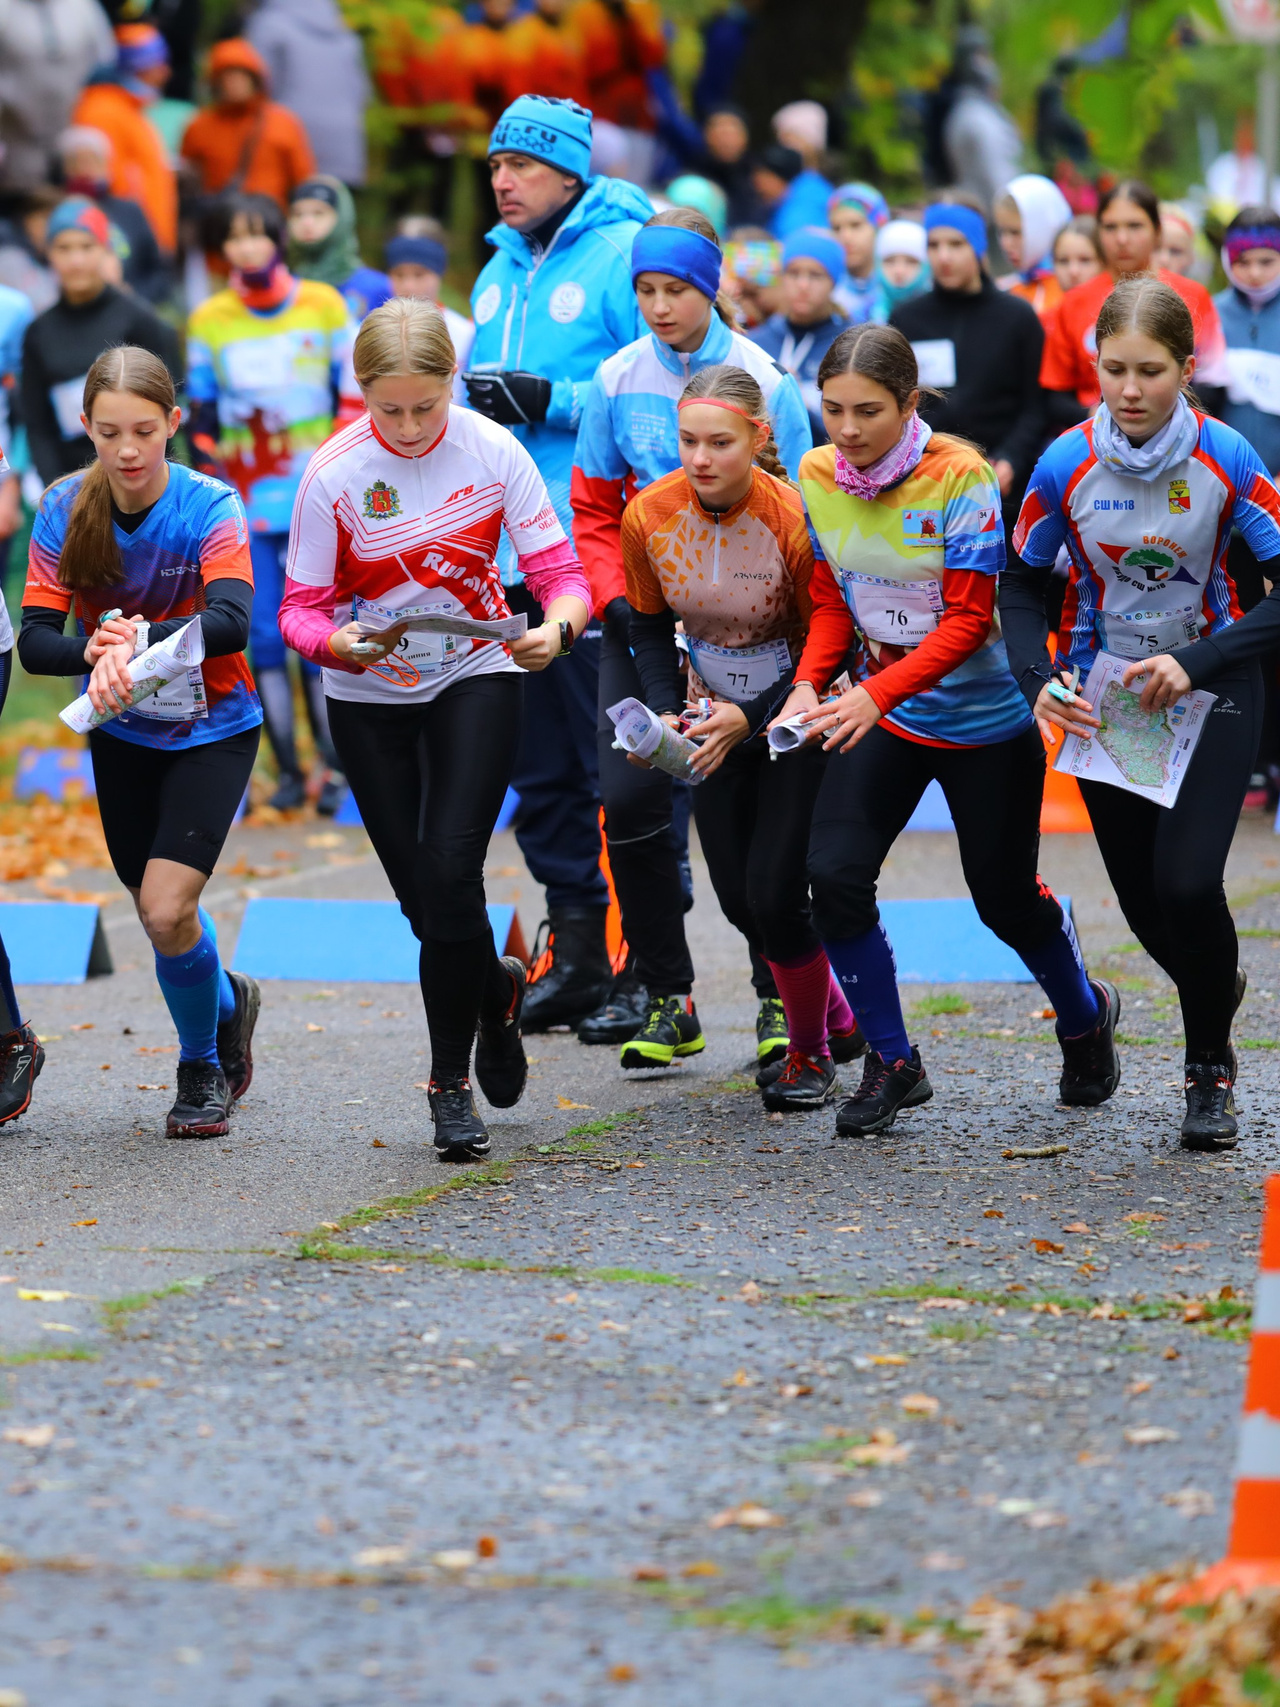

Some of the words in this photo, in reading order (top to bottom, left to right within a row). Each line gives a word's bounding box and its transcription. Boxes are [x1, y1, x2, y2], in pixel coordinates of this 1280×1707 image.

[1094, 500, 1110, 511] СШ
[1113, 500, 1135, 511] №18
[1142, 535, 1188, 559] ВОРОНЕЖ
[886, 609, 908, 626] 76
[1134, 634, 1159, 648] 75
[727, 672, 749, 687] 77
[1213, 707, 1242, 715] DEMIX
